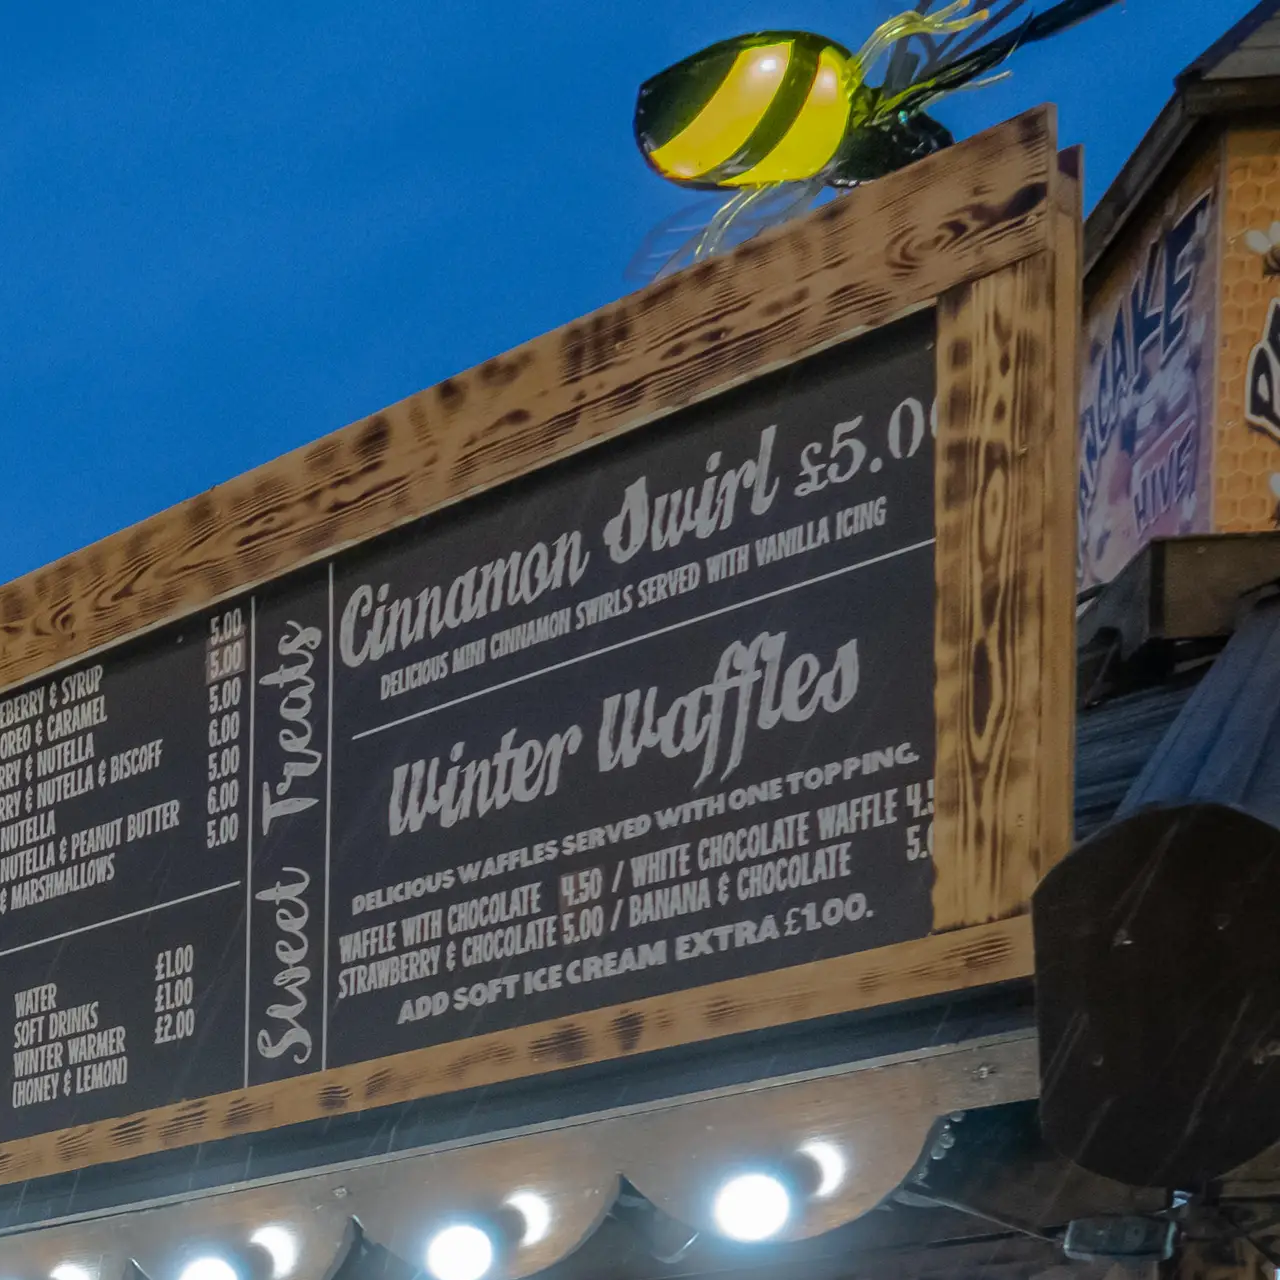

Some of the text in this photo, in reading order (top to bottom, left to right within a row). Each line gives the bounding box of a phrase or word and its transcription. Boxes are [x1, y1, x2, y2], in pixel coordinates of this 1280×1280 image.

[340, 528, 590, 667] Cinnamon
[603, 425, 779, 564] Swirl
[380, 496, 887, 700] DELICIOUS MINI CINNAMON SWIRLS SERVED WITH VANILLA ICING
[0, 724, 31, 760] OREO
[47, 695, 108, 742] CARAMEL
[209, 642, 243, 680] 5.00
[61, 664, 103, 705] SYRUP
[210, 607, 243, 646] 5.00
[36, 733, 95, 778] NUTELLA
[209, 677, 242, 714] 5.00
[36, 764, 94, 809] NUTELLA
[110, 738, 164, 782] BISCOFF
[208, 710, 241, 747] 6.00
[390, 631, 860, 836] Winter Waffles
[0, 810, 56, 856] NUTELLA
[208, 745, 240, 782] 5.00
[0, 843, 55, 887] NUTELLA
[71, 817, 124, 861] PEANUT
[127, 799, 181, 842] BUTTER
[207, 779, 240, 815] 6.00
[255, 620, 322, 1064] Sweet Treats
[352, 742, 920, 915] DELICIOUS WAFFLES SERVED WITH ONE TOPPING.
[10, 853, 115, 911] MARSHMALLOWS
[207, 812, 239, 849] 5.00
[339, 787, 898, 965] WAFFLE WITH CHOCOLATE 4.50 WHITE CHOCOLATE WAFFLE
[338, 841, 852, 1000] STRAWBERRY CHOCOLATE 5.00 BANANA CHOCOLATE
[396, 893, 874, 1025] ADD SOFT ICE CREAM EXTRA £1.00.
[13, 976, 194, 1049] SOFT DRINKS £1.00
[14, 944, 194, 1018] WATER £1.00
[13, 1009, 195, 1078] WINTER WARMER £2.00
[13, 1056, 128, 1109] (HONEY LEMON)
